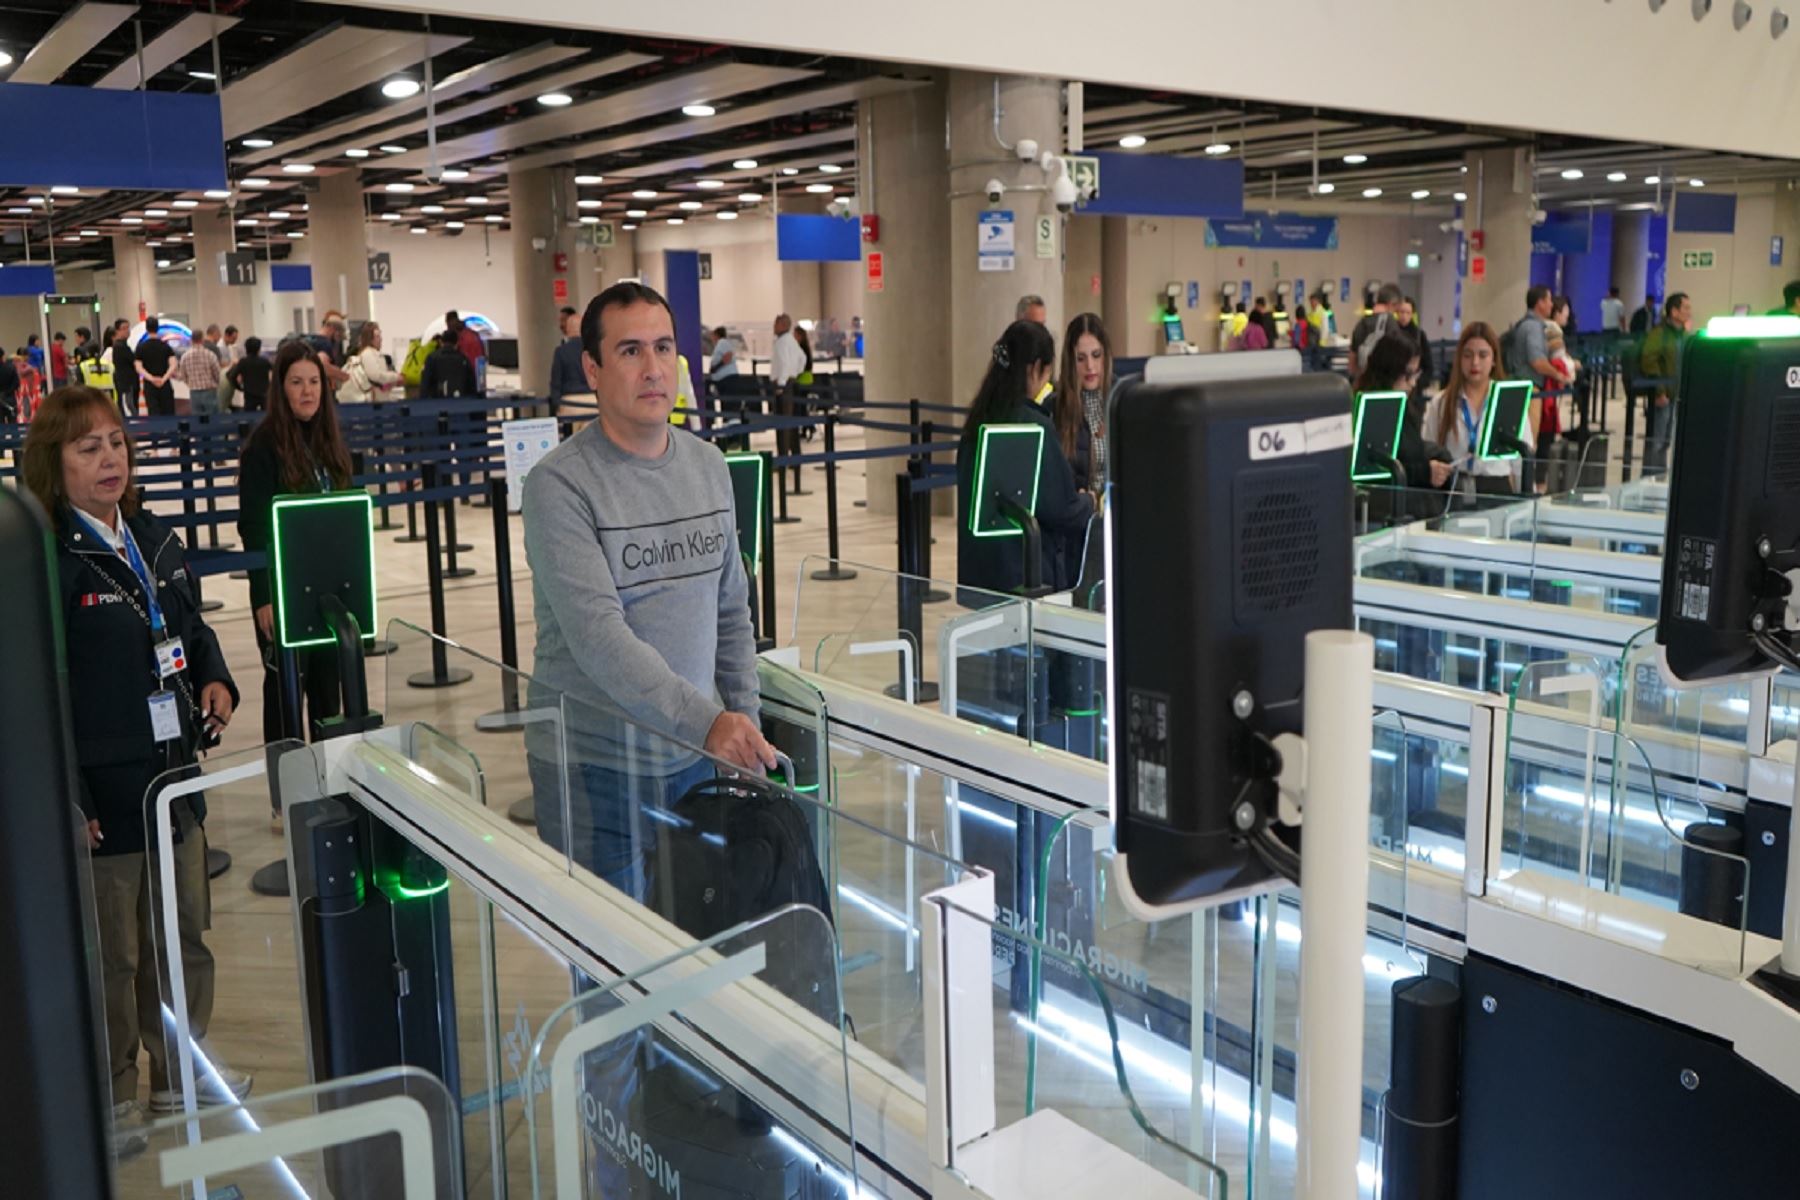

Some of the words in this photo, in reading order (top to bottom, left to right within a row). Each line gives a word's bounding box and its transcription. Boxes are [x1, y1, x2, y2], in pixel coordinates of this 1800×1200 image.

[1040, 218, 1051, 239] S
[236, 263, 254, 282] 11
[371, 262, 389, 281] 12
[1258, 431, 1286, 452] 06
[622, 538, 686, 570] Calvin
[686, 529, 725, 557] Klein
